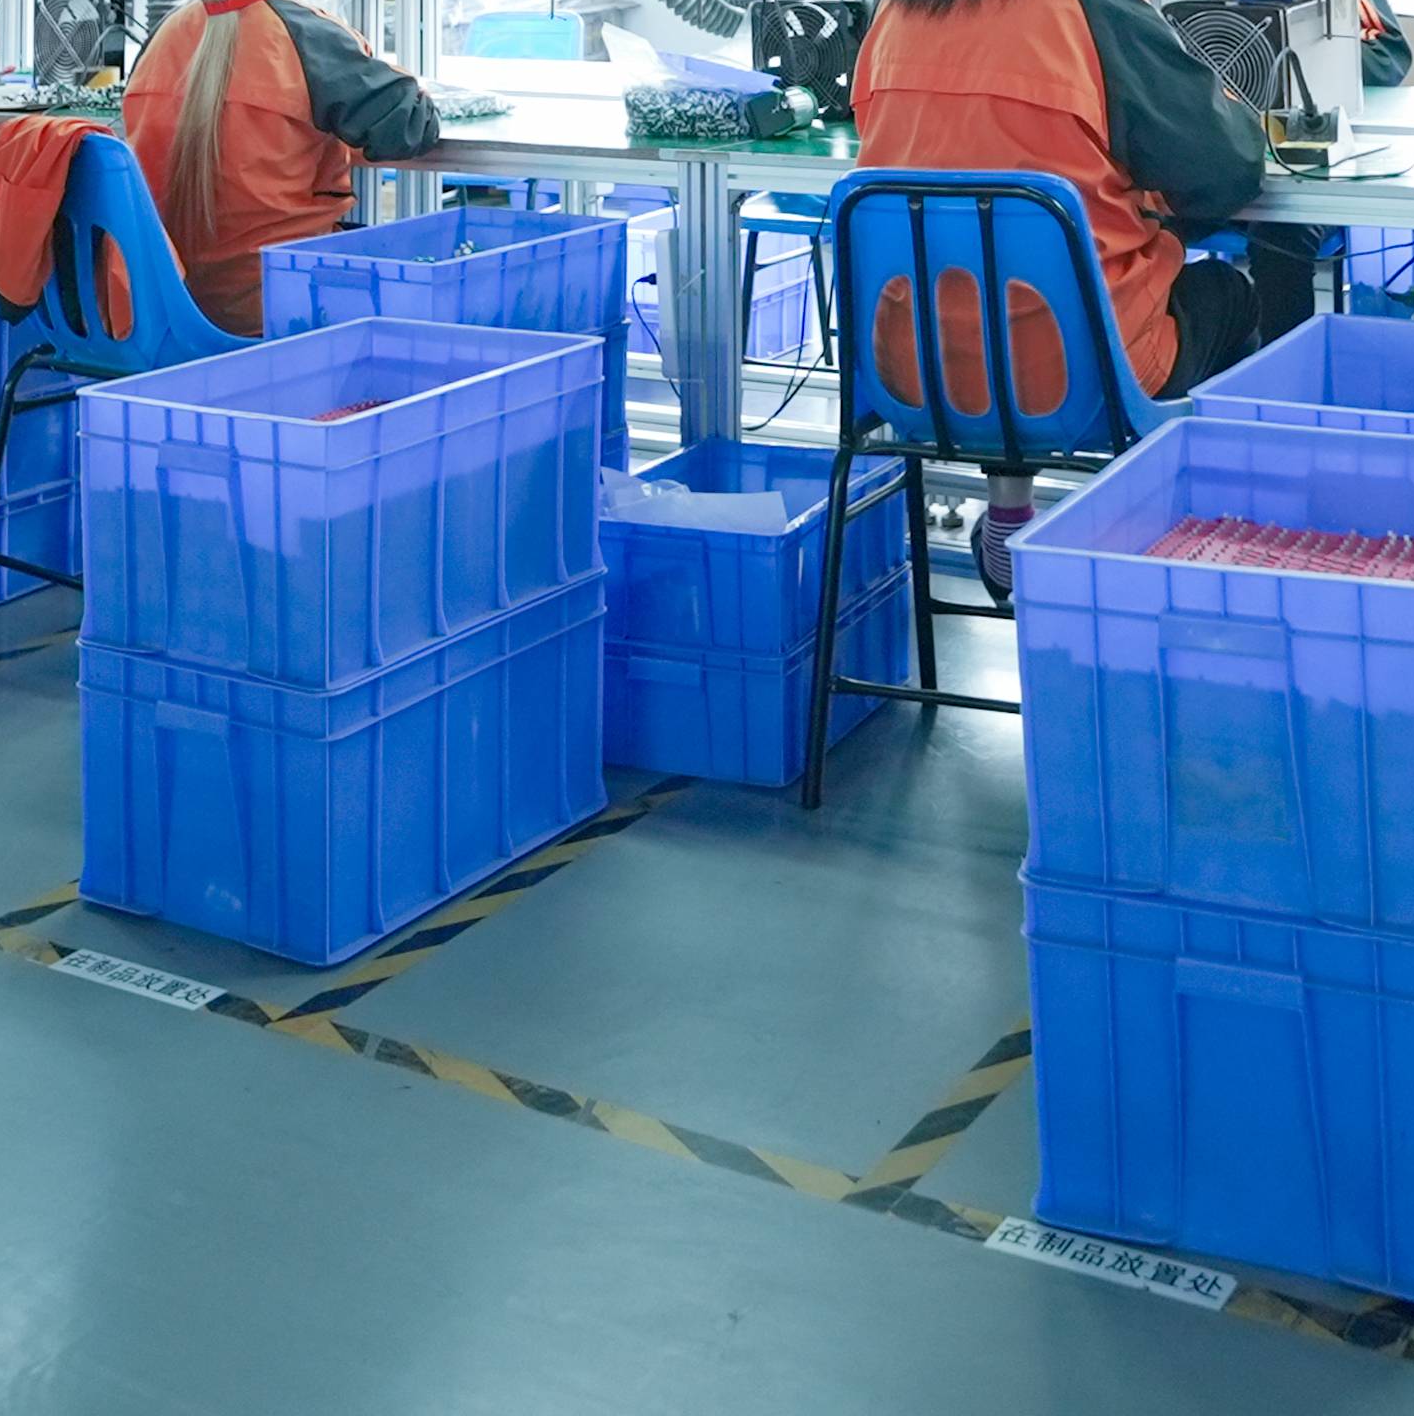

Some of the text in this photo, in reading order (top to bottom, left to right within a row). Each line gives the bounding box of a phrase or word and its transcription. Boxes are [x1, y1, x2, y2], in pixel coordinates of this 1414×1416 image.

[63, 953, 207, 1005] 在制品放置处
[997, 1221, 1223, 1300] 在制品放置处
